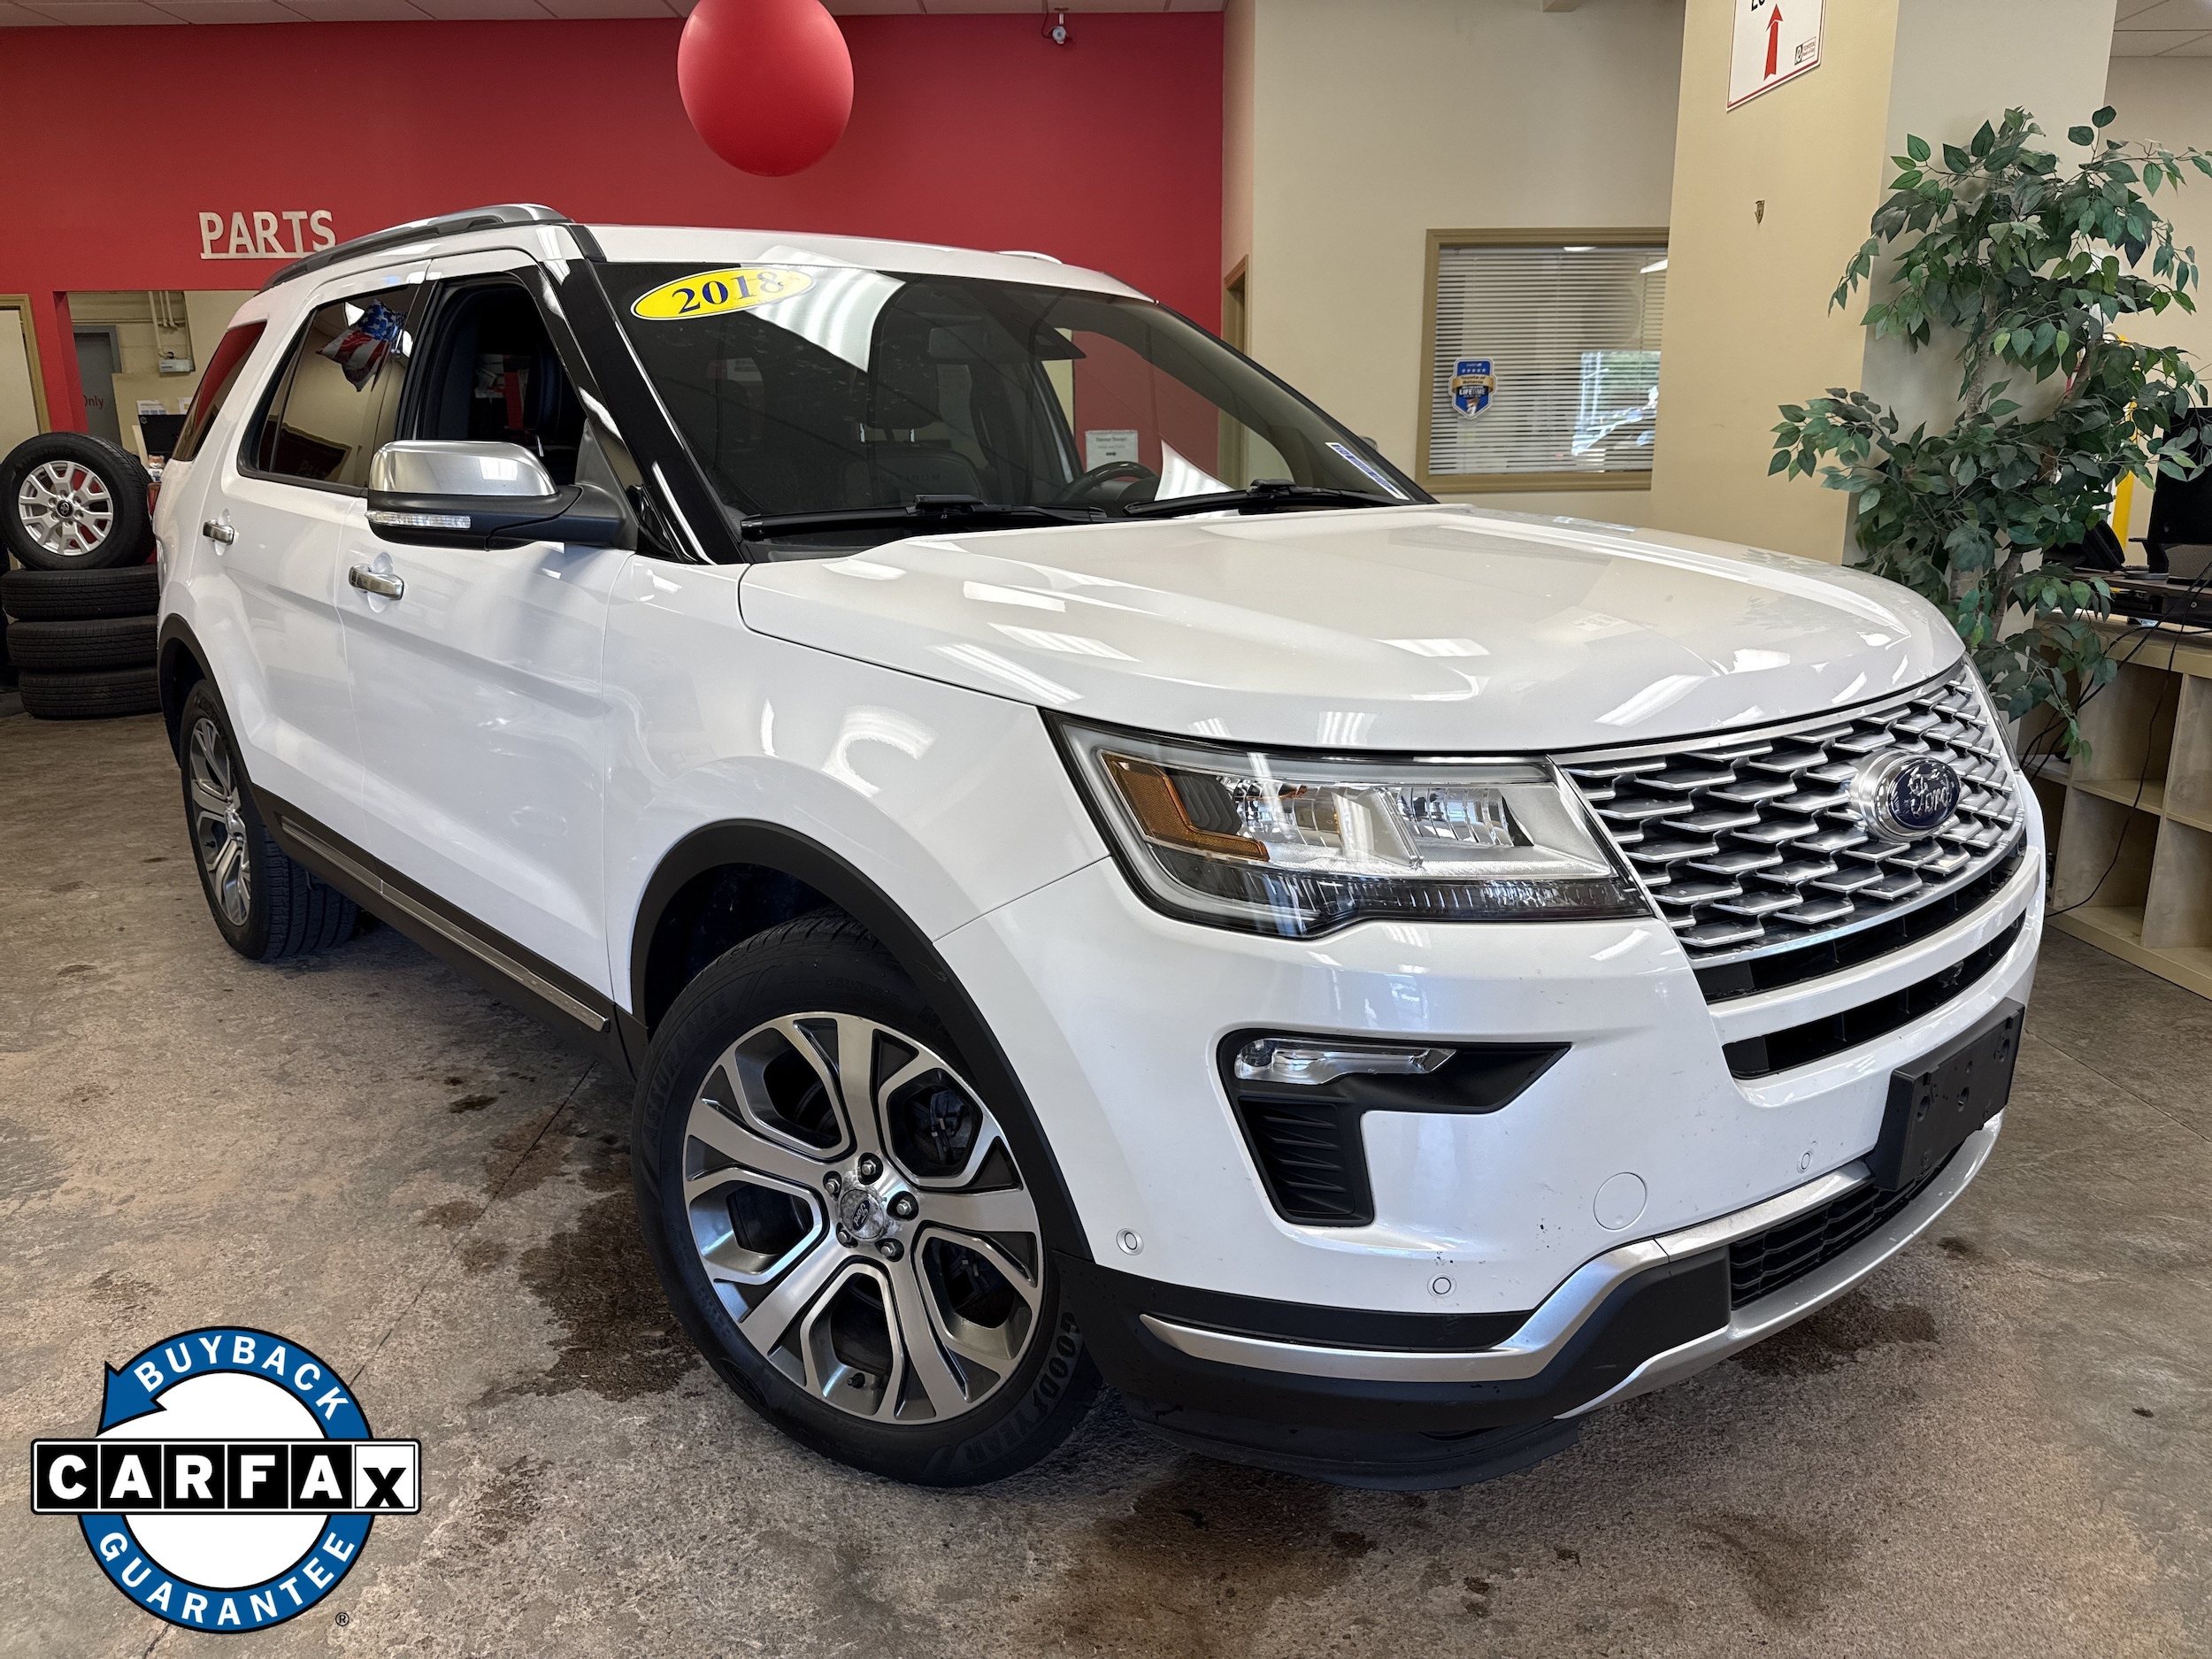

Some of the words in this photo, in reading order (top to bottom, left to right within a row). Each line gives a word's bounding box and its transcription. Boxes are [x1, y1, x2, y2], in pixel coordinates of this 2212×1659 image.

[199, 210, 336, 255] PARTS
[672, 271, 784, 314] 2018
[1908, 766, 1954, 819] Ford
[853, 1202, 868, 1227] Ford
